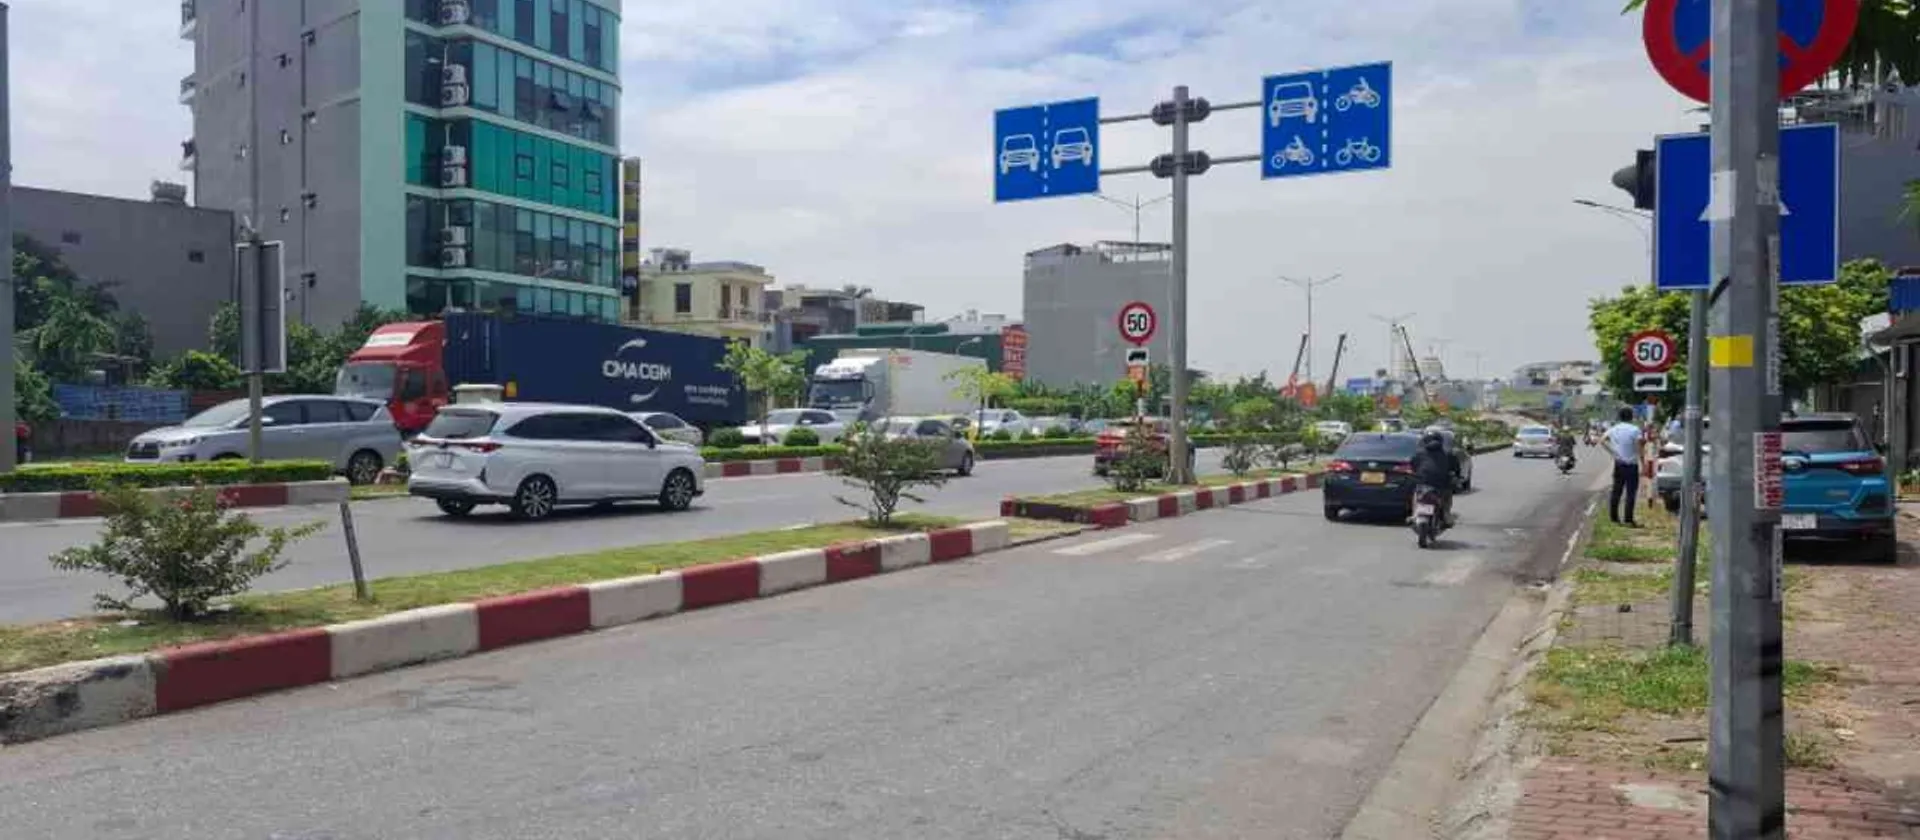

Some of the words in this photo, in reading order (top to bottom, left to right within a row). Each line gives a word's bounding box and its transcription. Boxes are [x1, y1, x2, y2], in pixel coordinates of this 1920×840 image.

[1127, 313, 1148, 332] 50
[1638, 342, 1664, 361] 50
[602, 360, 638, 379] CMA
[639, 363, 672, 381] CGM
